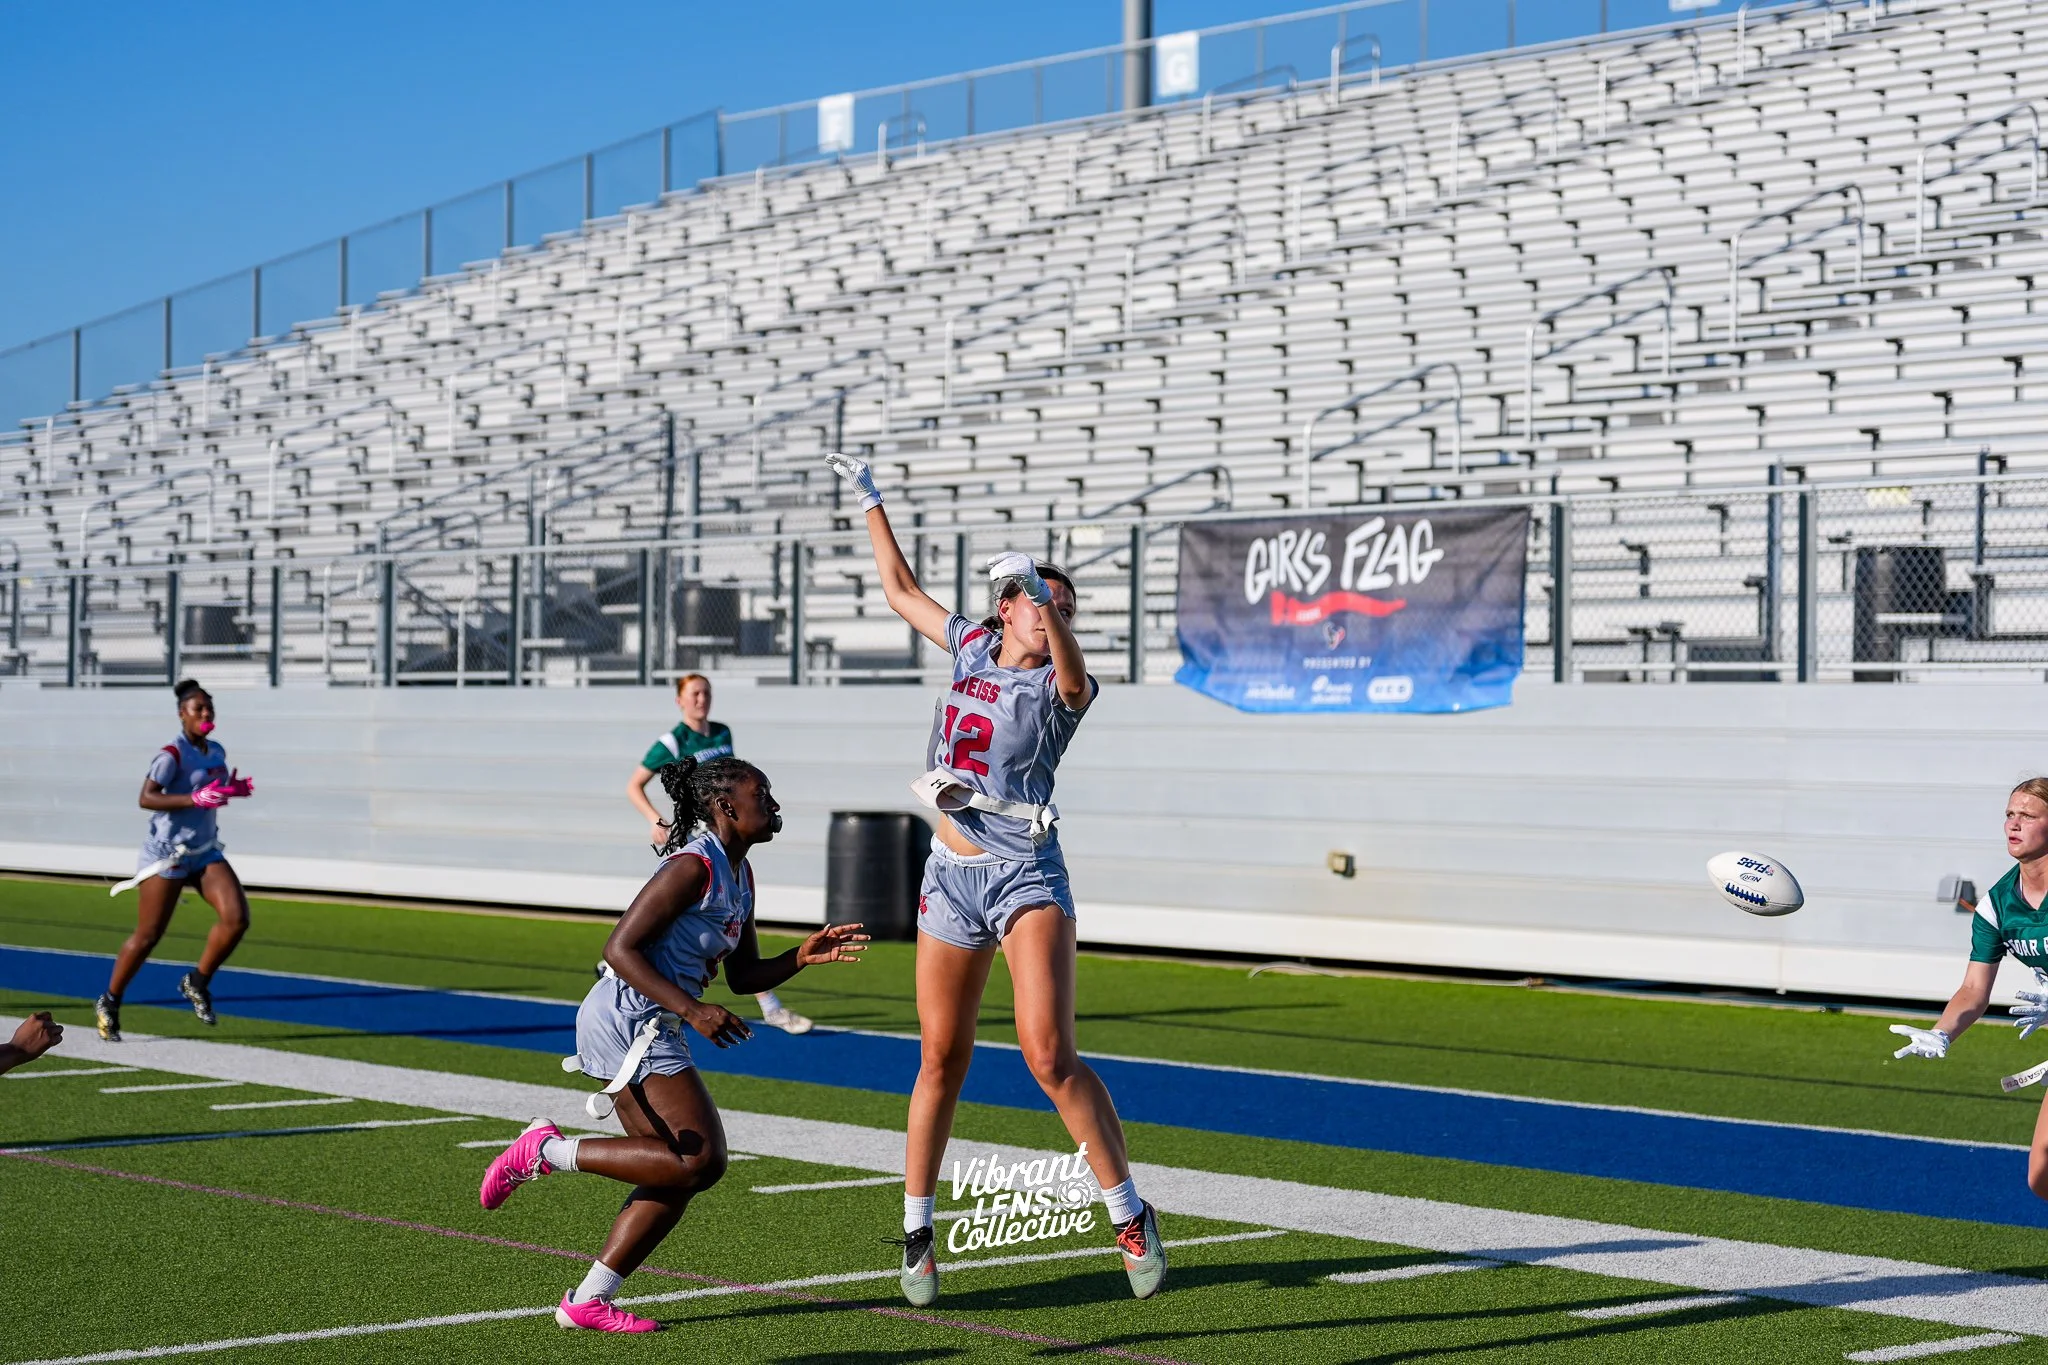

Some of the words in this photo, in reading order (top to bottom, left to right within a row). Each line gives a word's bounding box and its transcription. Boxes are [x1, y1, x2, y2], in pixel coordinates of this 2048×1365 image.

[1245, 528, 1331, 604] GIRLS
[1340, 516, 1444, 591] FLAG
[944, 704, 994, 777] 12
